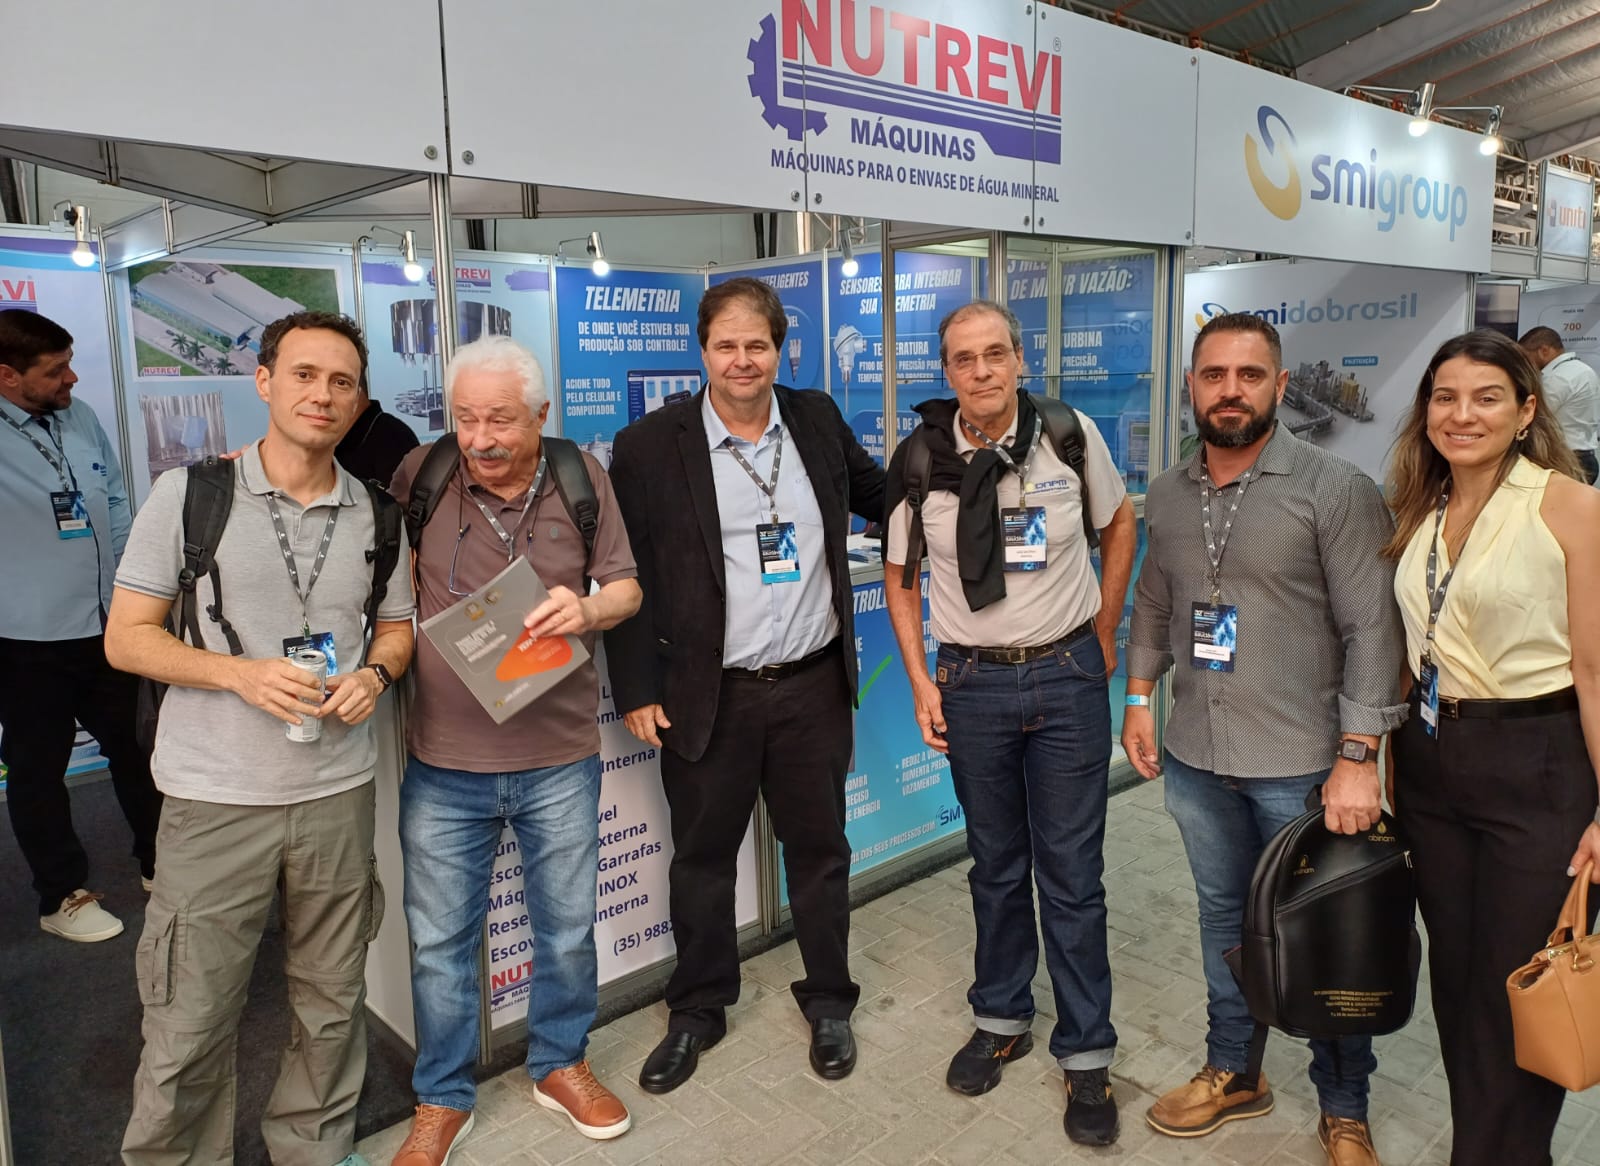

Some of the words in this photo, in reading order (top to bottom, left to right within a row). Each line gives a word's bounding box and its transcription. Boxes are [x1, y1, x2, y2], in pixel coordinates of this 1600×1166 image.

[782, 0, 1061, 116] NUTREVI
[850, 117, 976, 162] MÁQUINAS
[771, 148, 854, 177] MÁQUINAS
[858, 163, 893, 182] PARA
[897, 167, 906, 184] O
[910, 168, 957, 191] ENVASE
[960, 175, 975, 193] DE
[977, 174, 1008, 197] ÁGUA
[1011, 182, 1060, 203] MINERAL
[1310, 148, 1468, 241] smigroup
[432, 266, 491, 280] TREVI
[895, 273, 912, 291] ARA
[914, 268, 962, 289] INTEGRAR
[1010, 279, 1028, 300] DE
[1079, 265, 1133, 294] VAZÃO:
[0, 280, 36, 301] VI
[585, 286, 680, 313] TELEMETRIA
[860, 298, 878, 315] SUA
[578, 321, 589, 335] DE
[592, 322, 614, 336] ONDE
[617, 319, 638, 336] VOCÊ
[640, 323, 673, 336] ESTIVER
[674, 323, 690, 336] SUA
[1563, 322, 1581, 331] 700
[579, 336, 625, 356] PRODUÇÃO
[627, 339, 643, 352] SOB
[873, 341, 929, 356] TEERATURA
[1062, 331, 1102, 349] URBINA
[565, 378, 591, 389] ACIONE
[593, 378, 611, 389] TUDO
[566, 391, 583, 403] PELO
[585, 391, 616, 402] CELULAR
[617, 391, 622, 401] E
[903, 417, 912, 431] DE
[601, 748, 655, 773] Interna
[846, 789, 869, 807] RECISO
[598, 822, 647, 848] xterna
[598, 840, 661, 872] Garrafas
[599, 871, 638, 897] INOX
[594, 893, 649, 923] Interna
[489, 914, 529, 937] Rese
[613, 931, 641, 956] (35)
